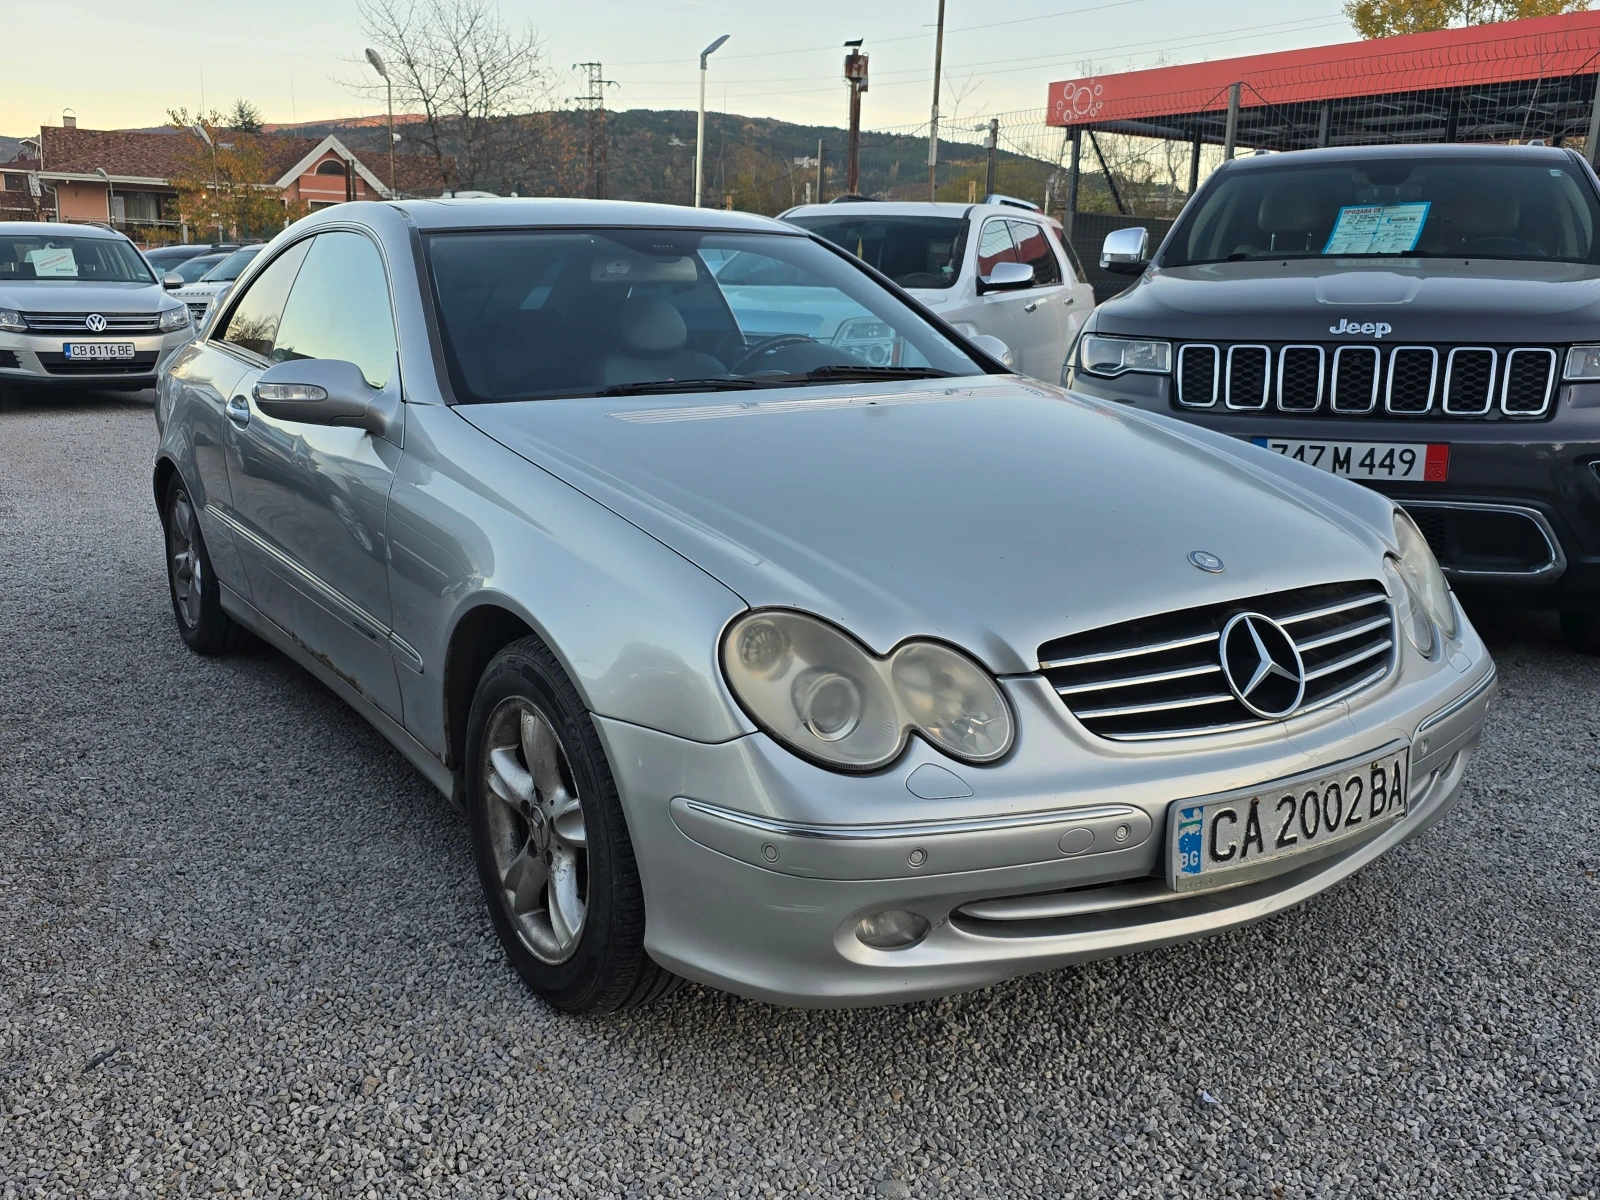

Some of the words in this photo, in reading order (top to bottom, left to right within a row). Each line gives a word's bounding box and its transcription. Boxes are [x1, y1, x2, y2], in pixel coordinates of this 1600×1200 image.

[1329, 318, 1392, 338] Jeep
[72, 345, 87, 356] CB
[89, 345, 116, 356] 8116
[117, 345, 133, 356] BE
[1332, 446, 1352, 474] M
[1358, 447, 1417, 476] 449
[1209, 800, 1264, 863] CA
[1274, 774, 1363, 849] 2002
[1369, 759, 1402, 820] BA
